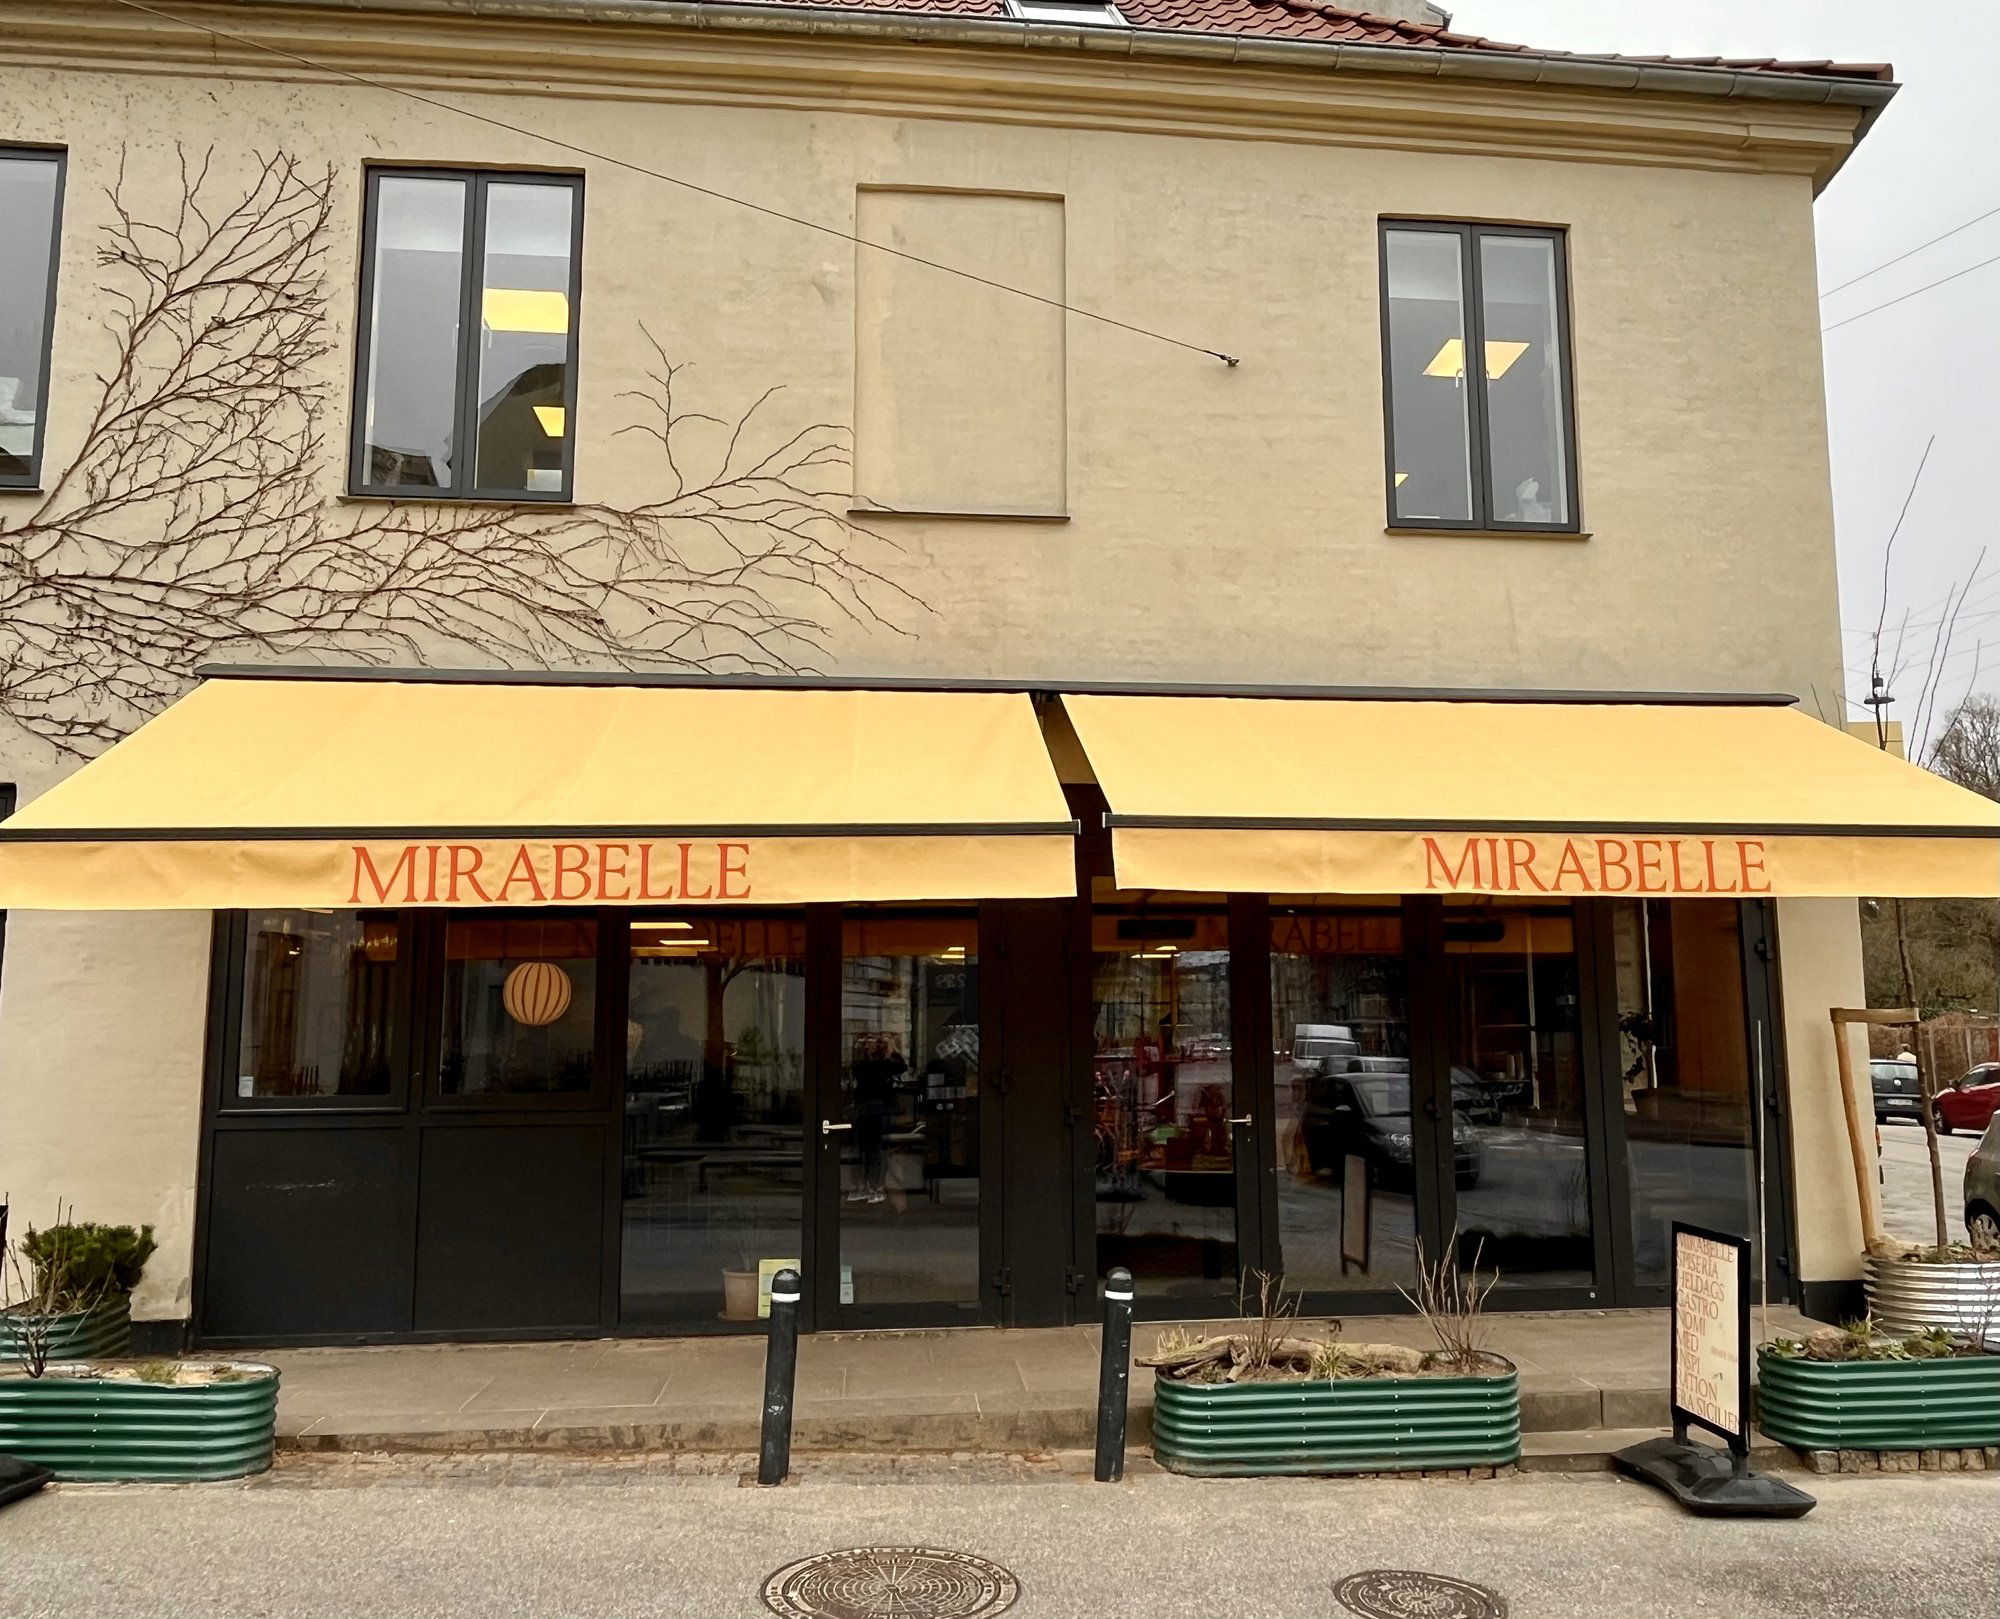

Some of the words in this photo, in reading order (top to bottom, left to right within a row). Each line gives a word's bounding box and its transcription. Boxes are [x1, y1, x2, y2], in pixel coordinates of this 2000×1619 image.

[348, 842, 751, 904] MIRABELLE
[1424, 835, 1771, 894] MIRABELLE
[1677, 1232, 1734, 1262] MIRABELLE
